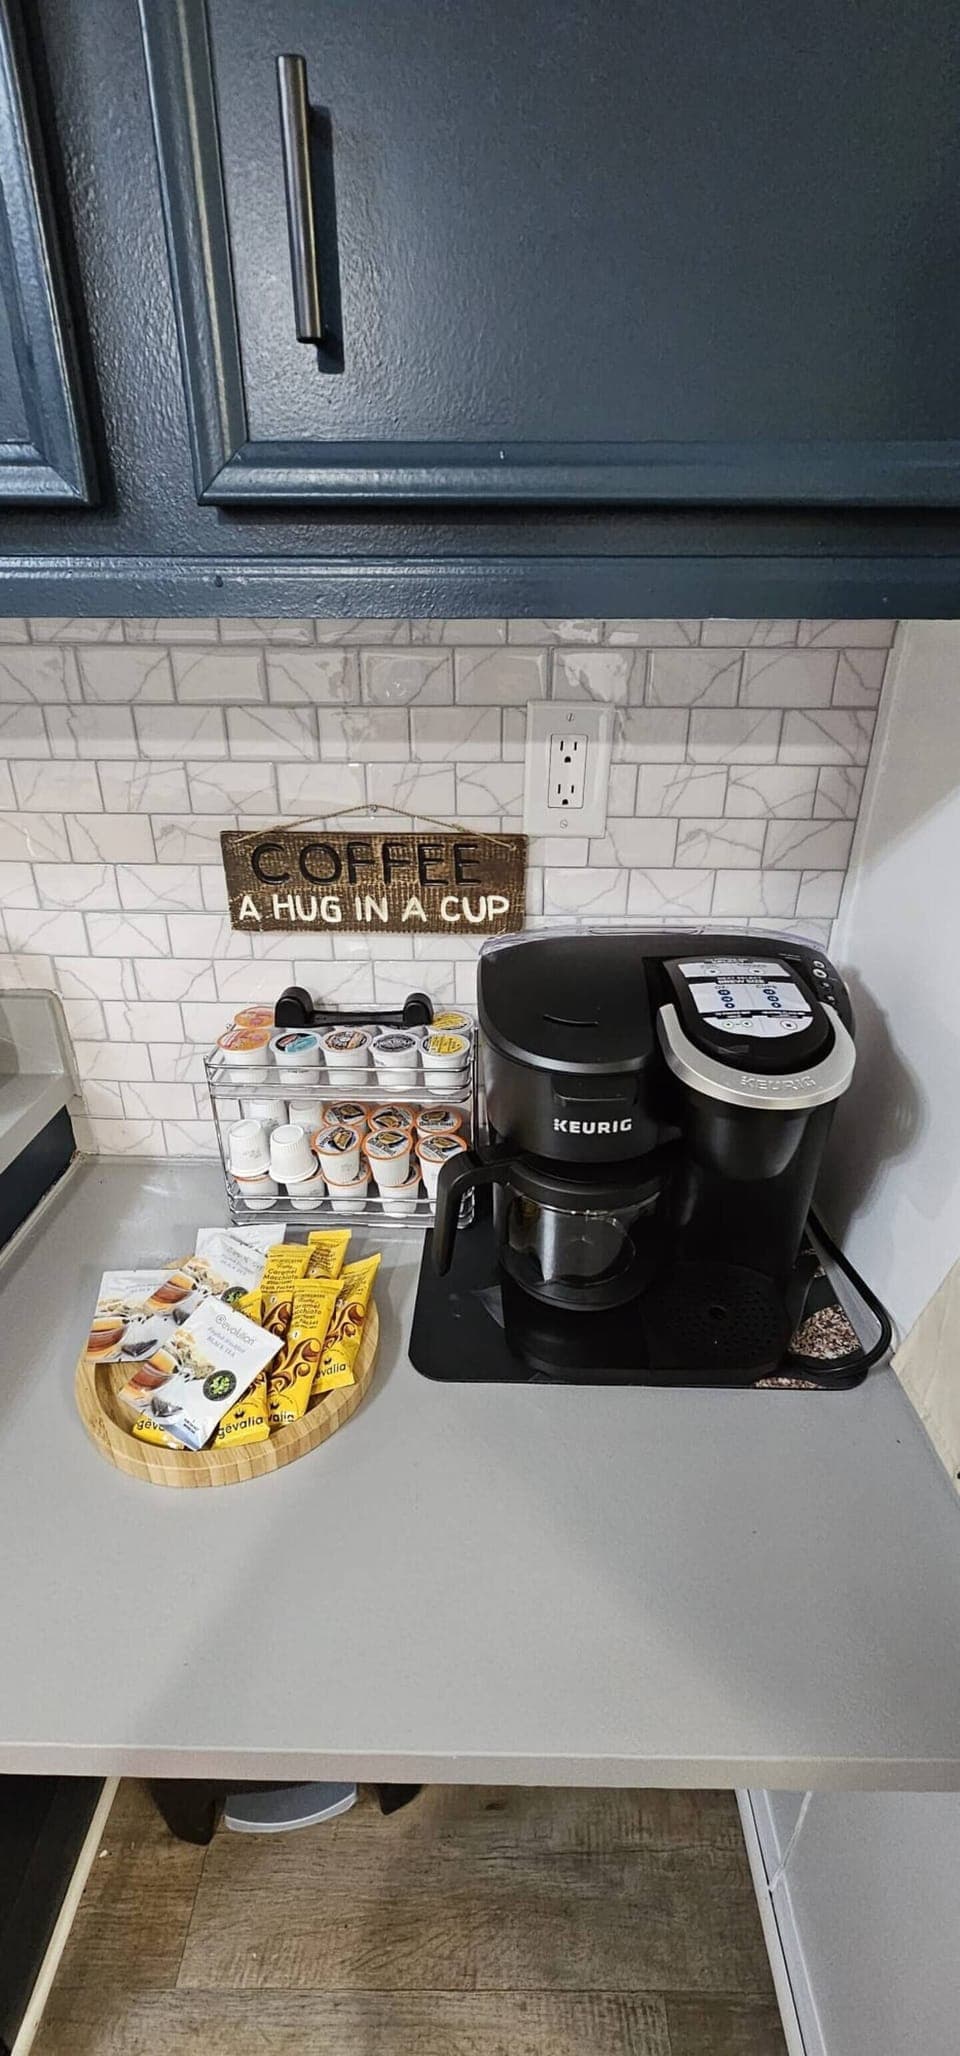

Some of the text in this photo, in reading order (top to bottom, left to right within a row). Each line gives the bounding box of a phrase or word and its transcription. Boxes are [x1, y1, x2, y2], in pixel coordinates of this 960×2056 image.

[251, 841, 482, 887] COFFEE
[239, 894, 510, 923] A HUG IN A CUP
[741, 1075, 816, 1091] KEURIG
[553, 1118, 632, 1134] KEURIG
